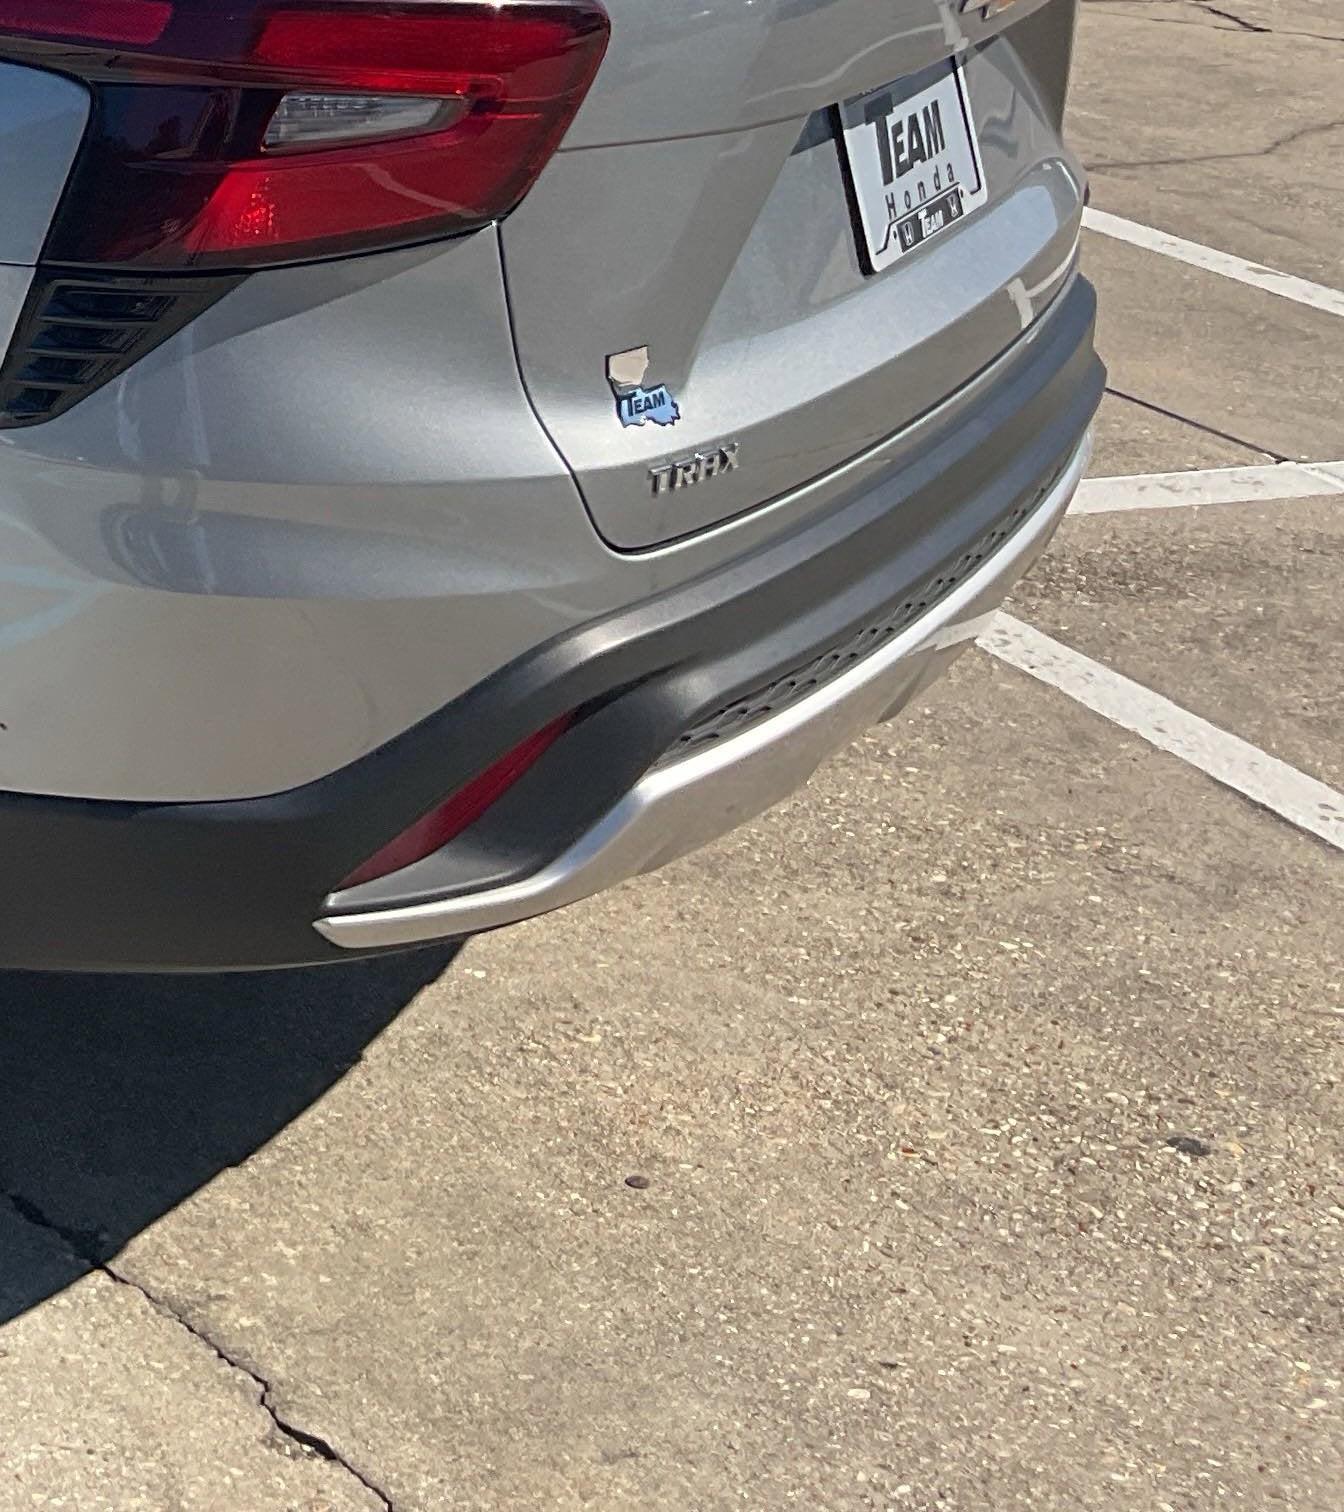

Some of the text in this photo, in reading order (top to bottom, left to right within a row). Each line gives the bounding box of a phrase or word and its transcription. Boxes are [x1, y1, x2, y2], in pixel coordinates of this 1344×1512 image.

[864, 91, 945, 186] TEAM
[884, 162, 955, 220] Honda
[917, 208, 944, 238] TEAM
[619, 391, 665, 417] TEAM
[648, 442, 739, 494] TRAX
